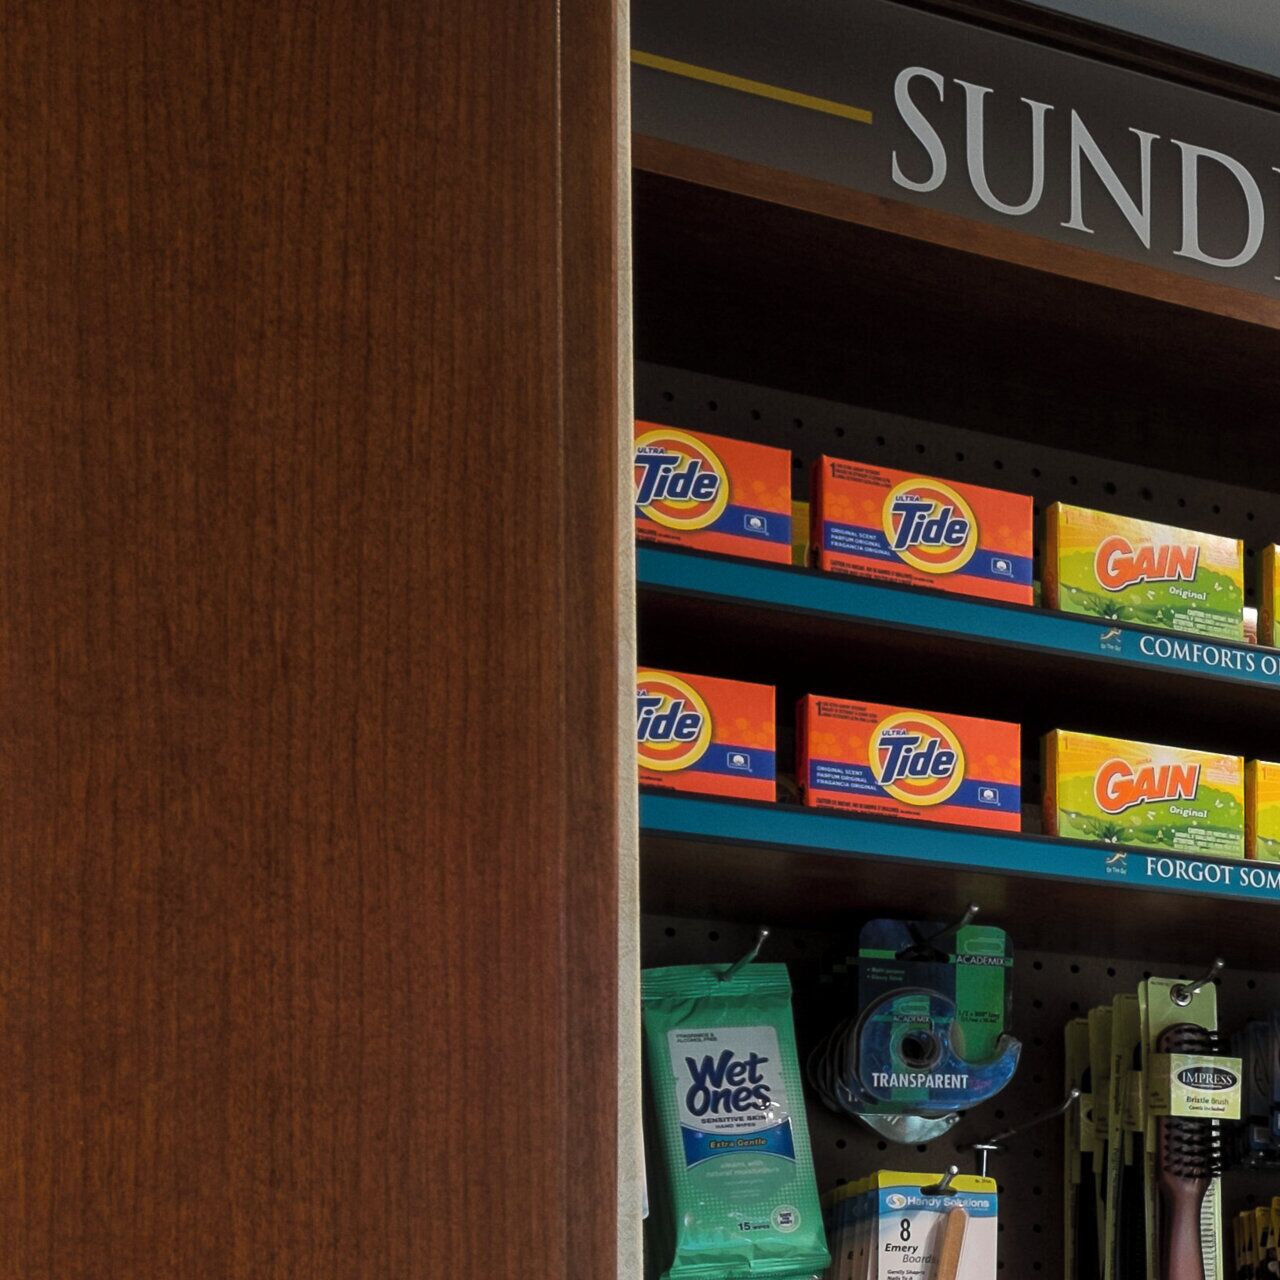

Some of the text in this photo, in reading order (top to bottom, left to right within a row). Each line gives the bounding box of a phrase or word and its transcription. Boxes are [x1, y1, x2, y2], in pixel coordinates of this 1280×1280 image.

[635, 454, 719, 506] Tide
[831, 528, 877, 540] ORIGINAL SCENT
[891, 501, 969, 550] Tide
[1095, 536, 1199, 591] GAIN
[1169, 586, 1206, 600] Original
[1139, 635, 1256, 672] COMFORTS
[1146, 857, 1233, 885] FORGOT
[685, 1049, 769, 1088] Wet
[1182, 1071, 1233, 1086] IMPRESS
[872, 1072, 969, 1089] TRANSPARENT
[686, 1084, 771, 1117] Ones
[906, 1196, 990, 1208] Handy Solutions
[738, 1222, 751, 1231] 15
[900, 1218, 911, 1241] 8
[885, 1243, 918, 1255] Emery
